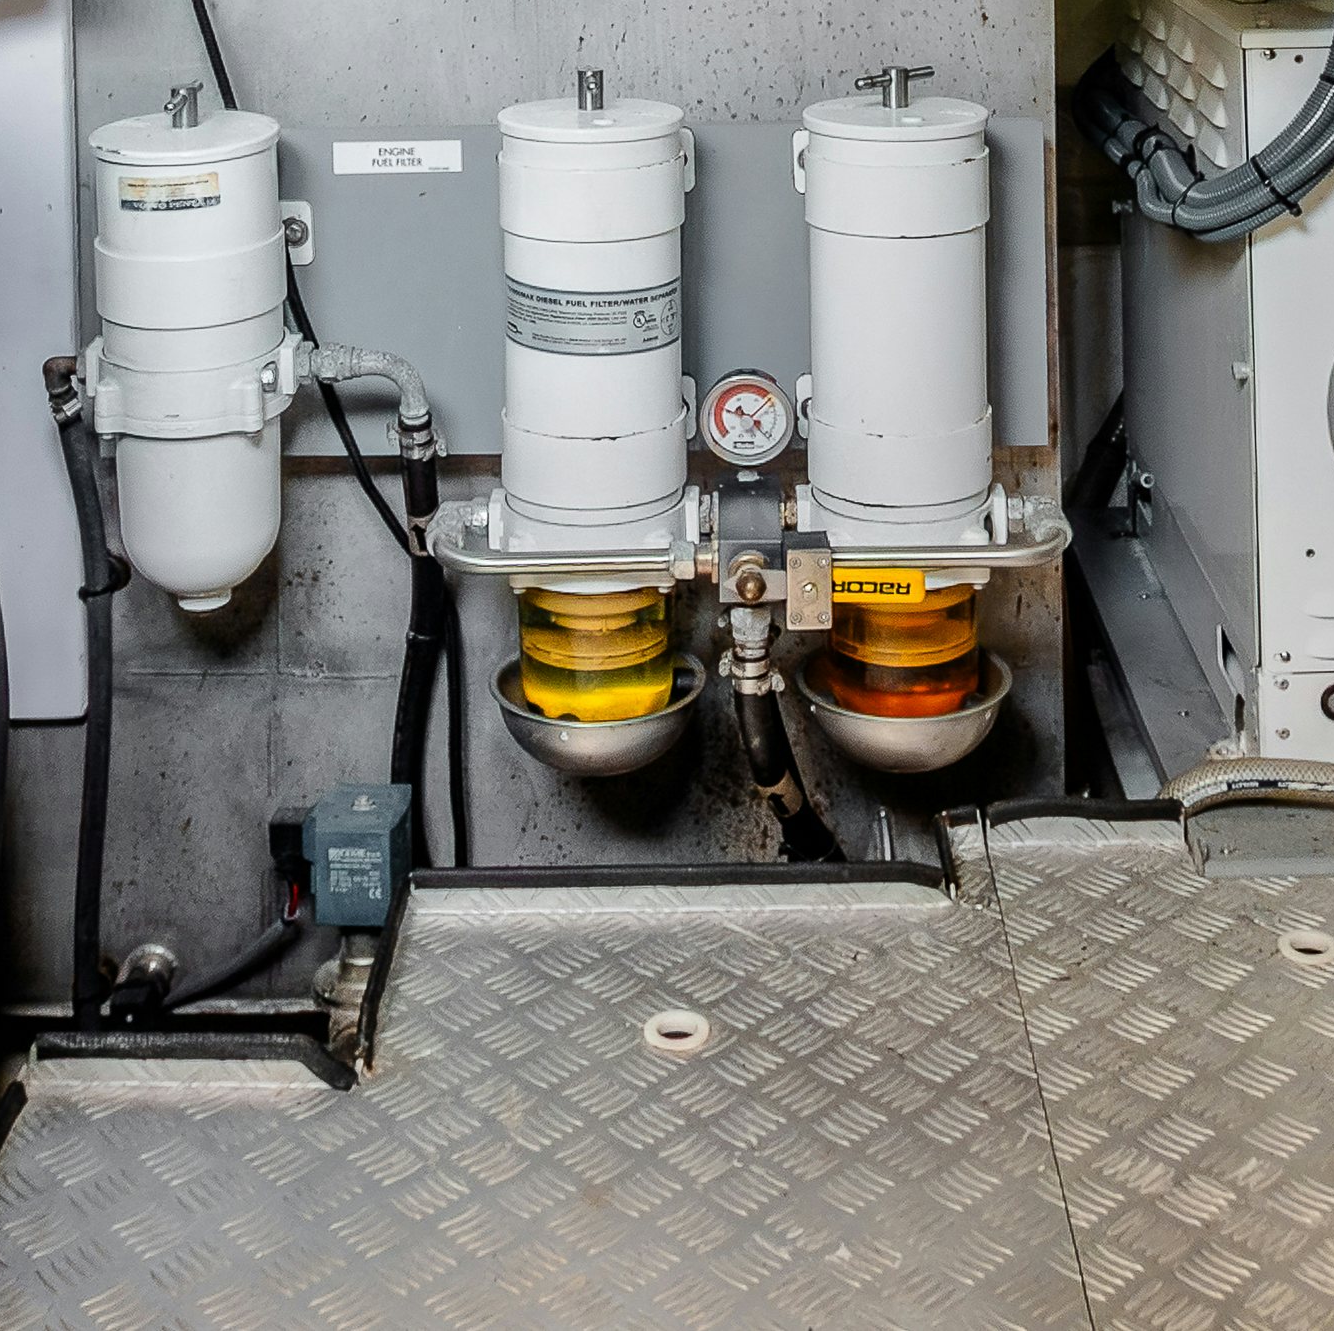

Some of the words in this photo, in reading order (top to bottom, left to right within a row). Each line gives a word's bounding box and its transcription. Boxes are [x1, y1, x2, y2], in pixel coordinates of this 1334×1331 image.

[378, 147, 416, 156] ENGINE
[371, 158, 393, 167] FUEL
[395, 157, 423, 166] FILTER
[535, 295, 563, 306] DIESEL
[565, 299, 588, 308] FUEL
[590, 296, 649, 308] FILTER/WATER
